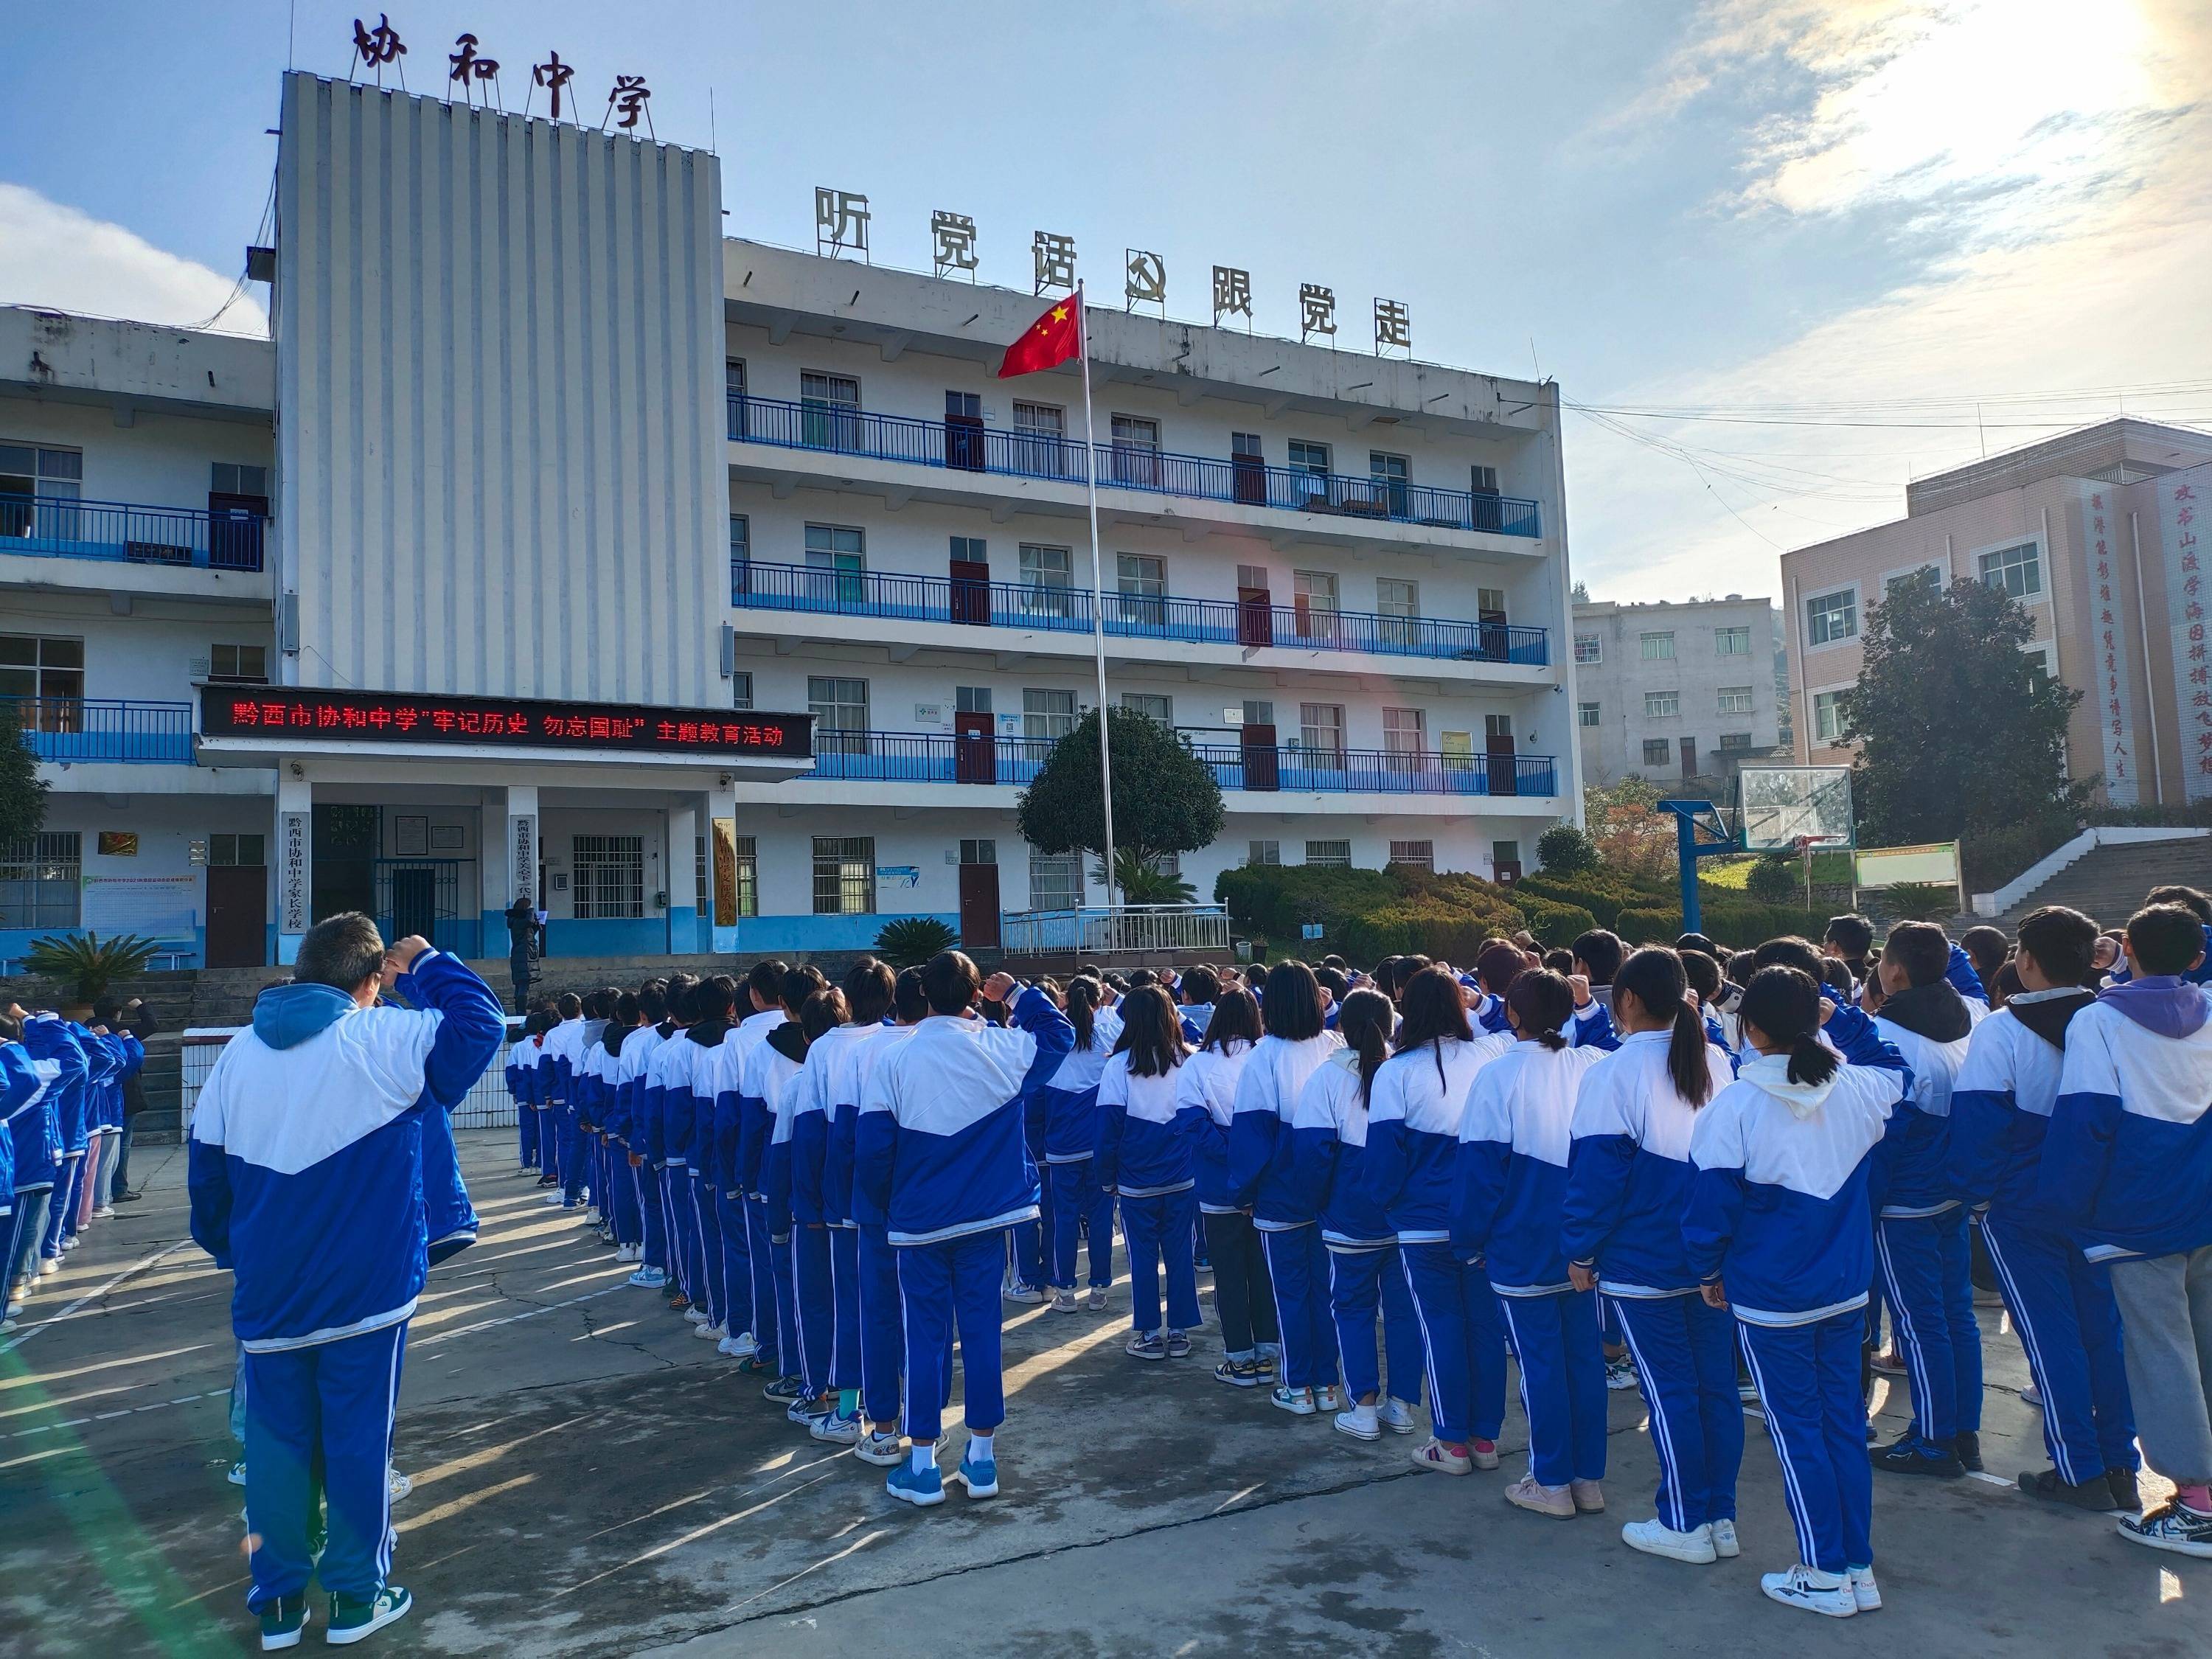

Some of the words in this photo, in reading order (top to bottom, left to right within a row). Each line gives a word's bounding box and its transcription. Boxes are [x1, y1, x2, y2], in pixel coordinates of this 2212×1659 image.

[354, 13, 651, 128] 协和中学
[817, 190, 1077, 286] 听党话
[1213, 265, 1411, 348] 跟党走
[656, 720, 783, 747] 主题教育活动
[288, 817, 302, 929] 黔西市协和中学家长学校
